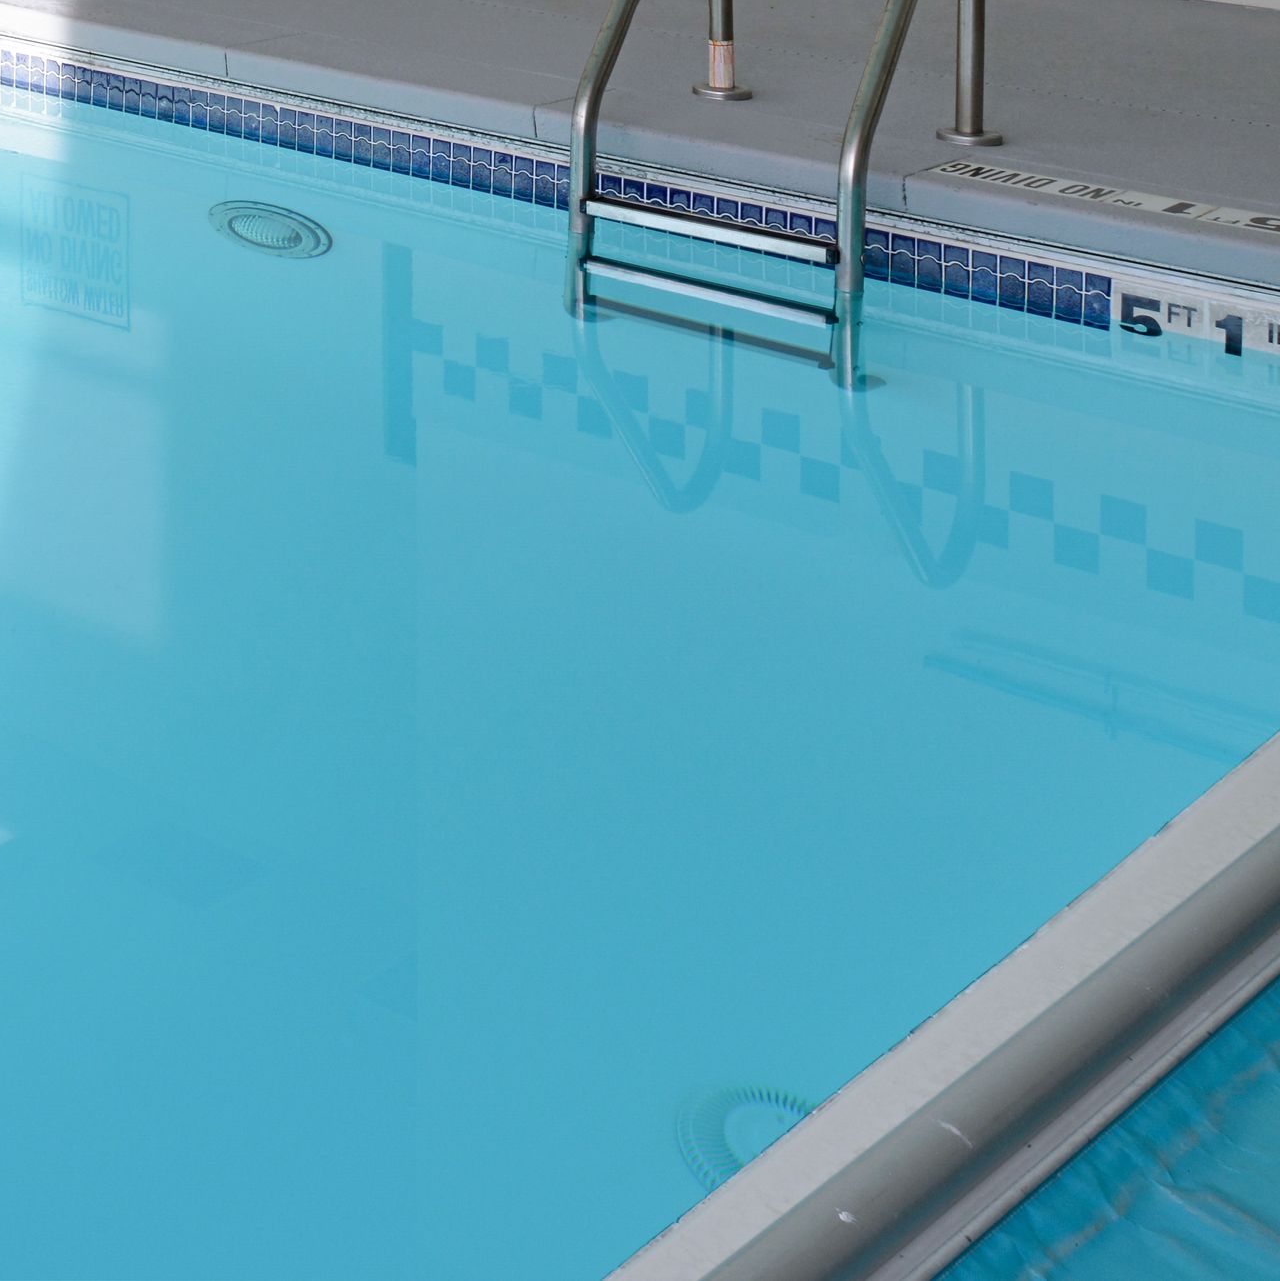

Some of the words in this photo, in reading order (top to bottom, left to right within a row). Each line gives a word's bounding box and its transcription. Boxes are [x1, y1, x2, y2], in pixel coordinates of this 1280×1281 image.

[940, 162, 1057, 189] DIVING
[1058, 185, 1116, 200] NO
[1113, 198, 1143, 207] IN
[1161, 202, 1196, 215] 1
[1119, 292, 1163, 337] 5
[1168, 302, 1198, 328] FT
[1215, 314, 1243, 357] 1
[1268, 322, 1280, 345] I
